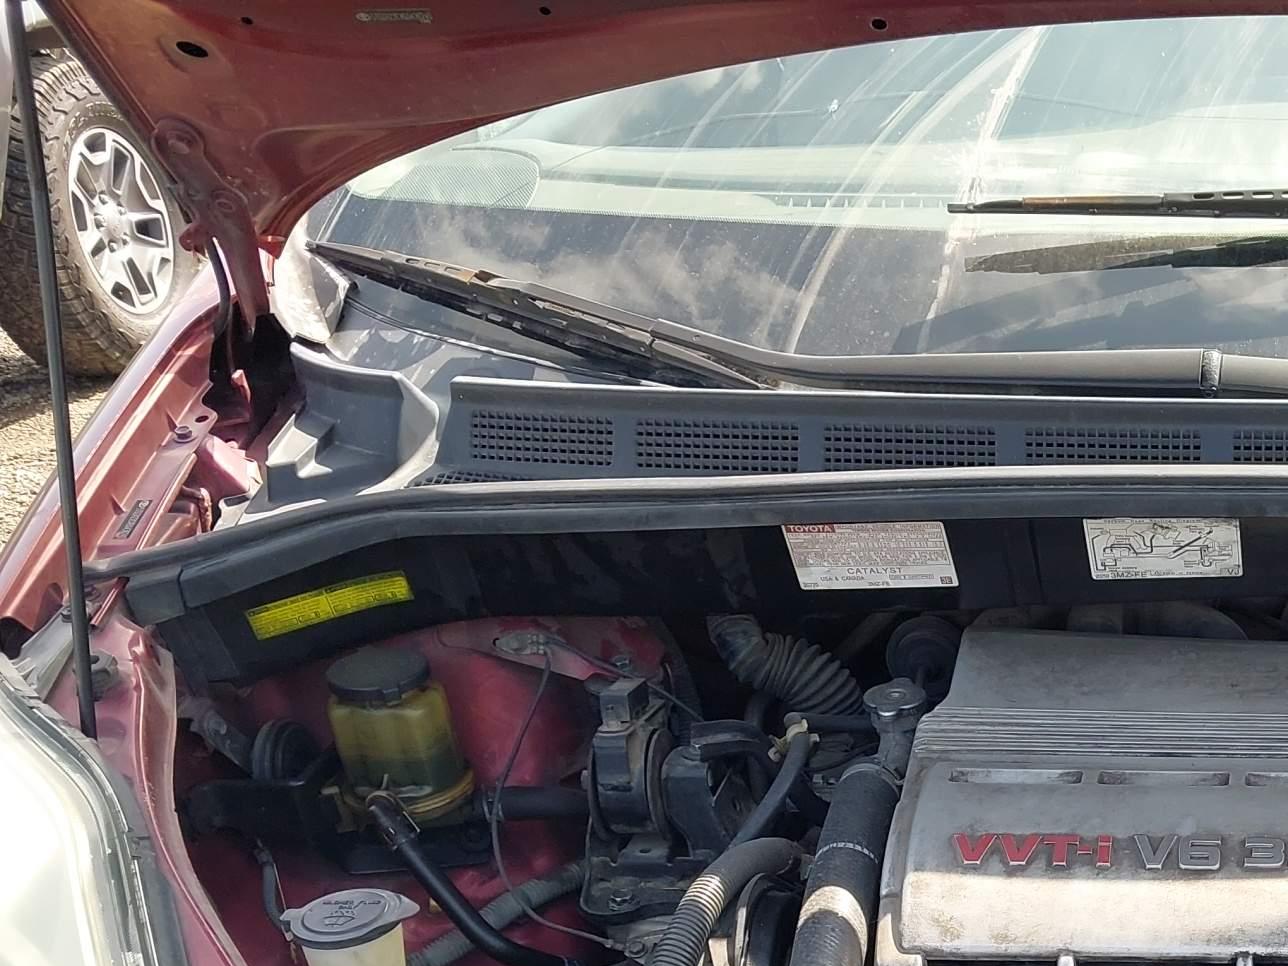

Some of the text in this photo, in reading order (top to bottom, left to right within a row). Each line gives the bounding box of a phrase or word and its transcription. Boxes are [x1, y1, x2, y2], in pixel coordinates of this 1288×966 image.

[847, 567, 903, 575] CATALYST
[951, 832, 1113, 866] VVT-i
[1132, 834, 1223, 870] V6
